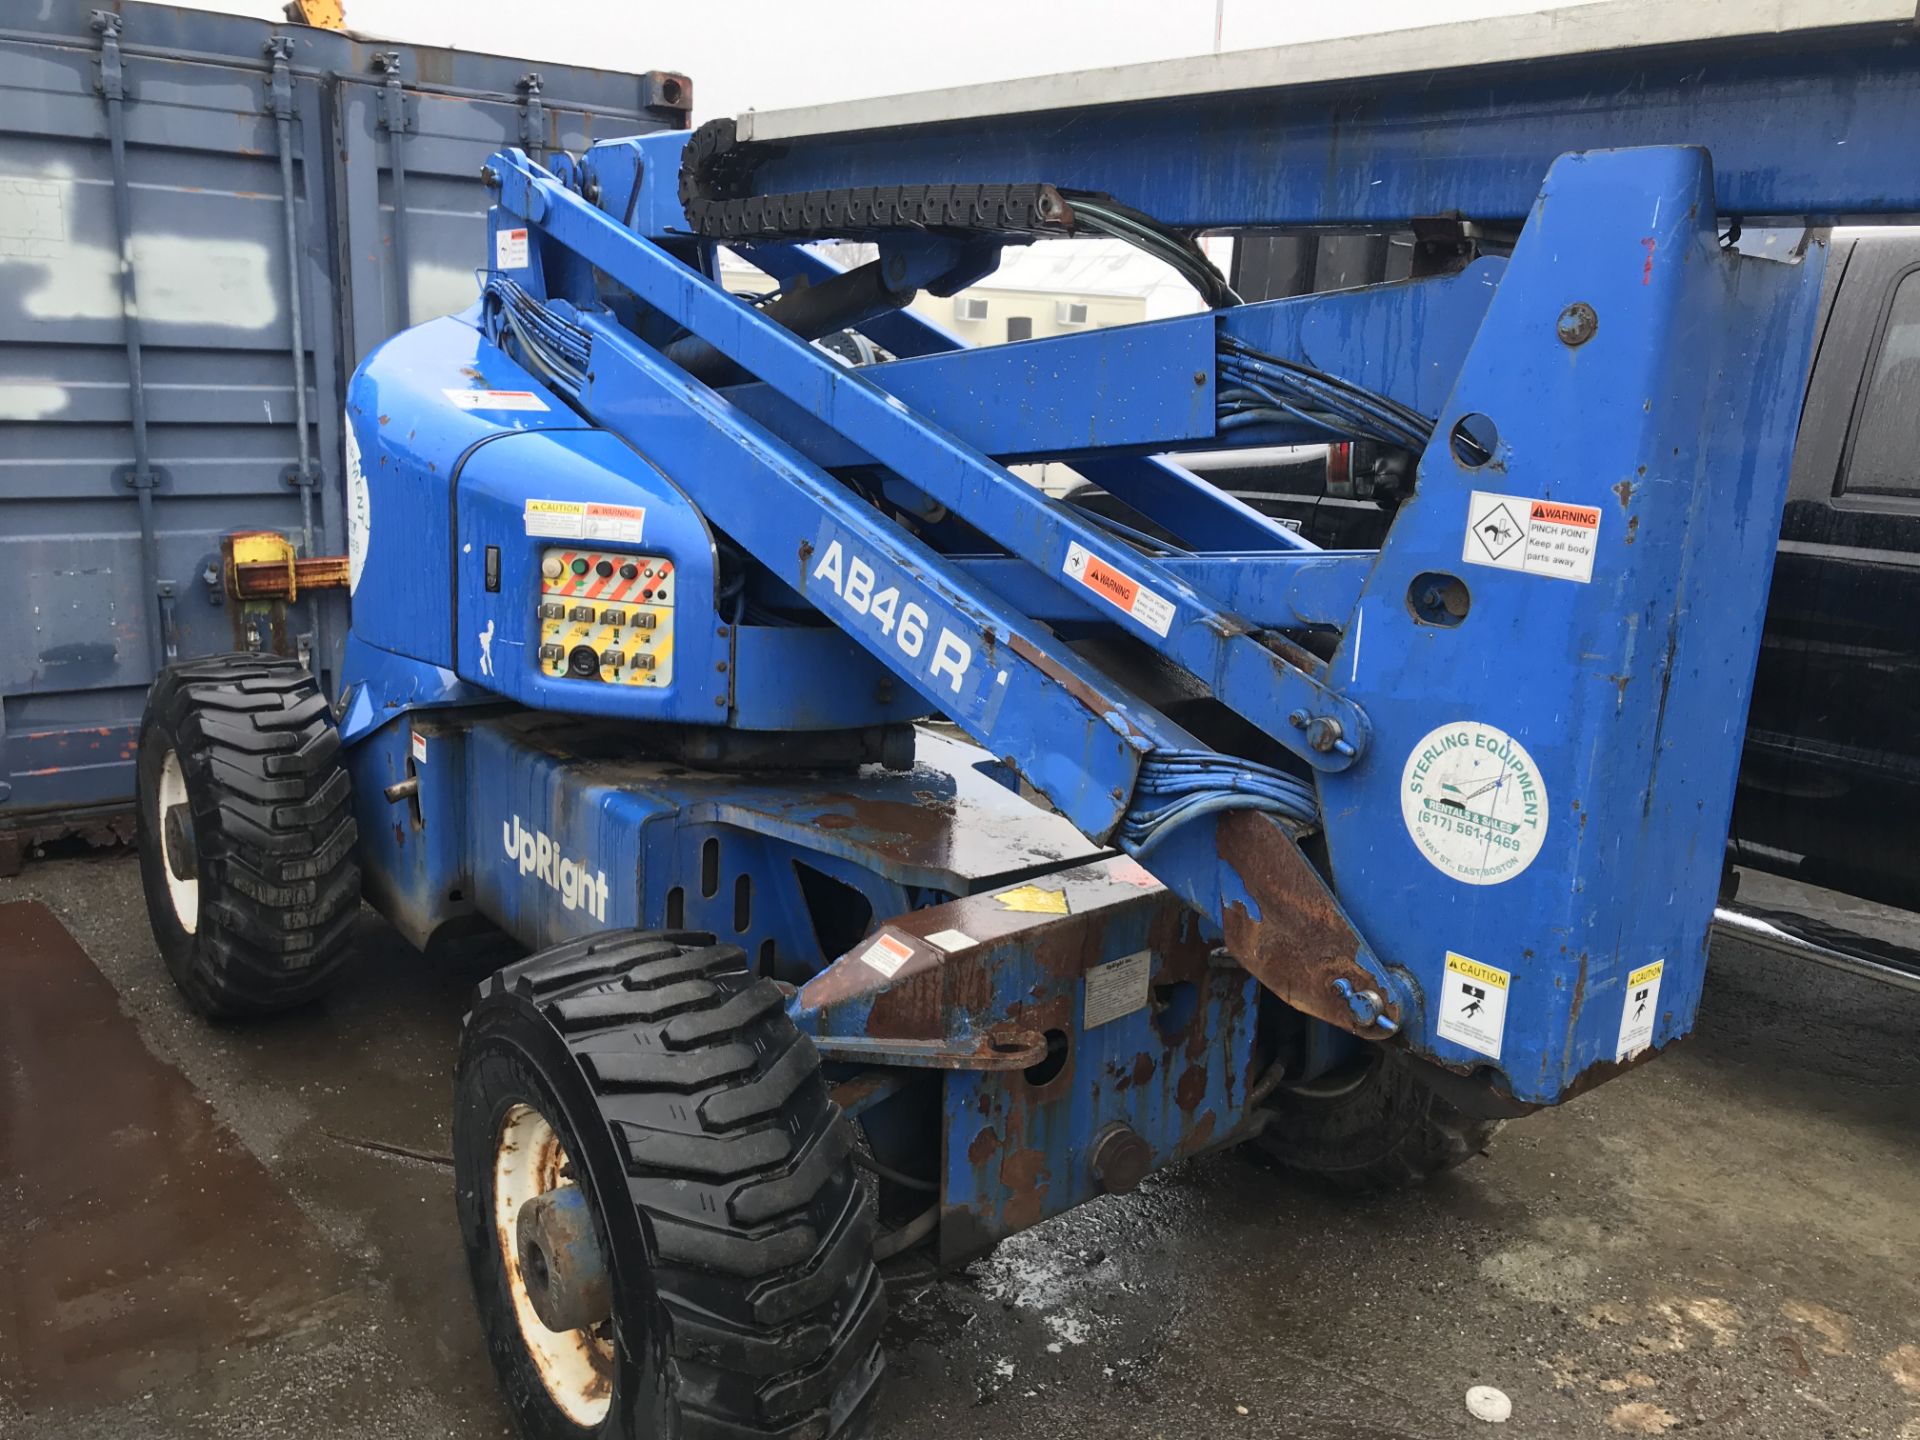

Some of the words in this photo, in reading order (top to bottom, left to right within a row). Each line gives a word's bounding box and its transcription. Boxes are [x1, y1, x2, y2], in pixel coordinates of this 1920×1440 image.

[540, 503, 580, 513] CAUTION
[602, 508, 635, 518] WARNING
[1545, 509, 1596, 524] WARNING
[1531, 524, 1558, 535] PINCH
[1561, 528, 1588, 539] POINT
[1529, 538, 1551, 549] Keep
[1568, 544, 1590, 556] body
[1527, 553, 1549, 562] parts
[1552, 557, 1575, 568] away
[1100, 572, 1131, 600] WARNING
[813, 539, 929, 658] AB46
[1410, 732, 1470, 794] STERLING
[1475, 733, 1538, 829] EQUIPMENT
[1429, 800, 1471, 821] RENTALS
[1472, 815, 1479, 823] &
[1482, 816, 1513, 833] SALES
[1418, 810, 1452, 832] (617)
[1456, 821, 1521, 852] 561-4469
[503, 814, 608, 923] UpRight
[1457, 864, 1480, 876] EAST
[1483, 856, 1519, 876] BOSTON
[1460, 962, 1506, 986] CAUTION
[1635, 965, 1662, 983] CAUTION
